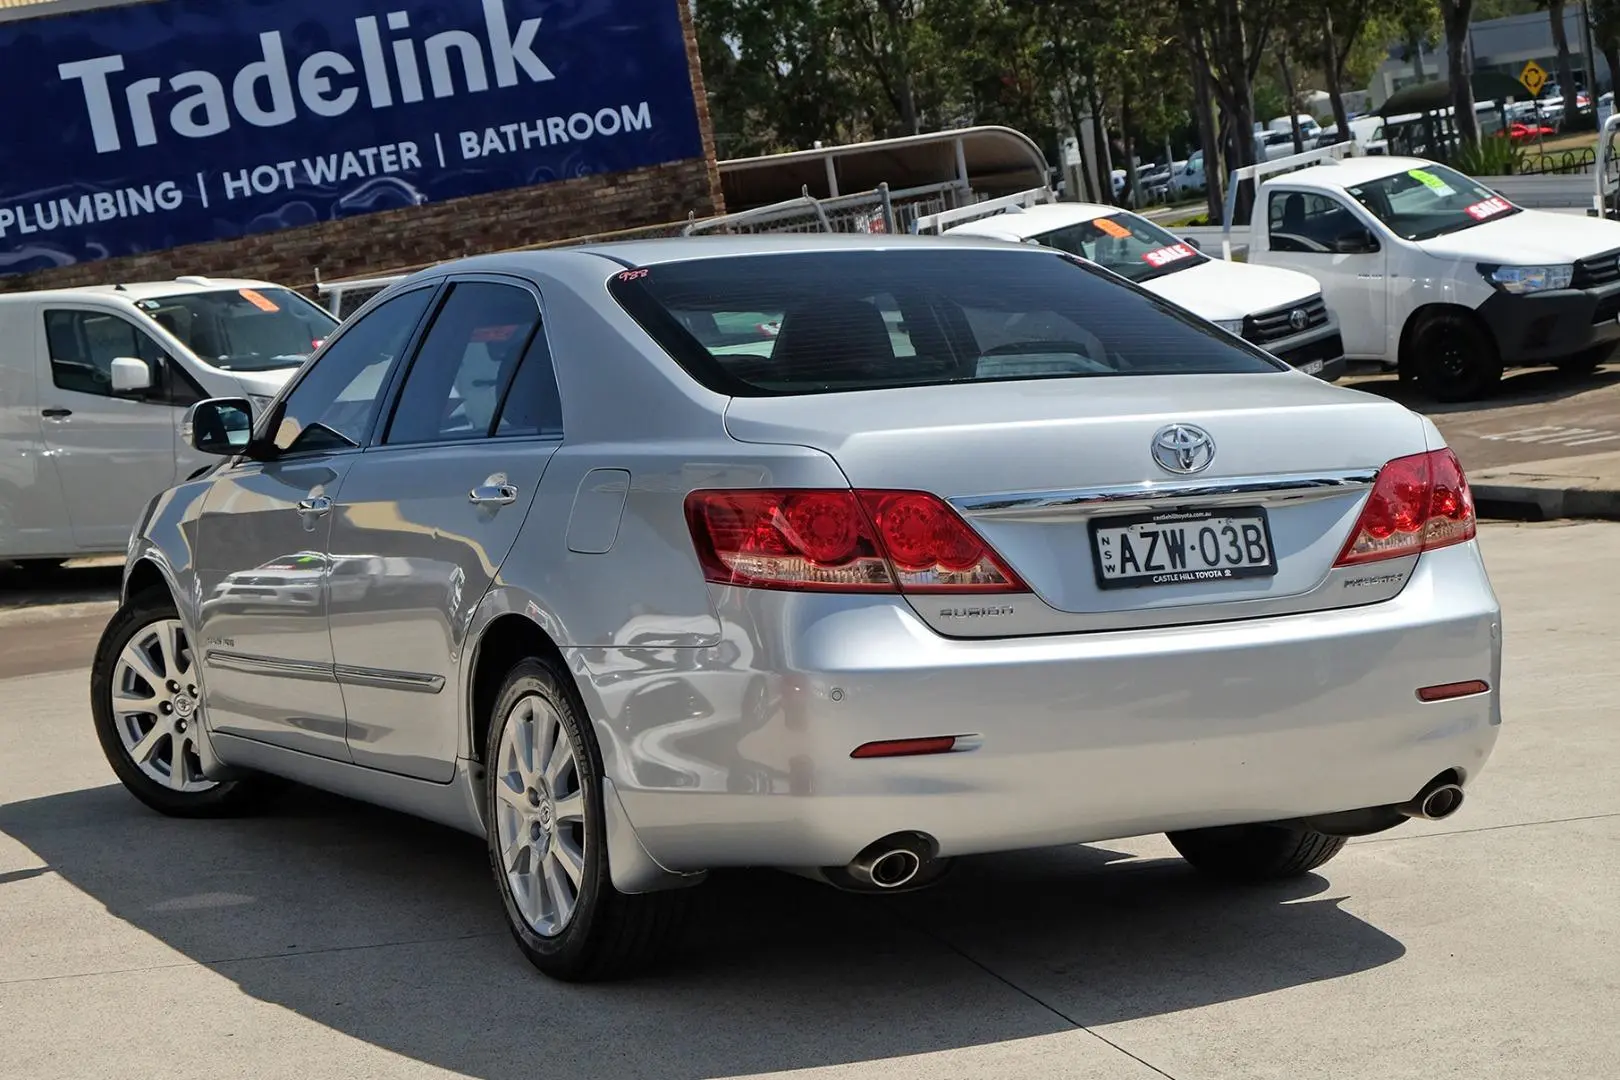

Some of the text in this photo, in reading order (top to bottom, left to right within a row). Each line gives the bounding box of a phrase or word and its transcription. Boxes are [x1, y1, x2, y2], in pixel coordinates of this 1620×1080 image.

[58, 0, 556, 153] Tradelink
[0, 101, 652, 238] PLUMBING HOT WATER BATHROOM
[1468, 197, 1509, 219] SALE
[1146, 244, 1192, 266] SALE
[1152, 511, 1212, 521] castlehilltoyota.com.au
[1152, 569, 1223, 583] CASTLE HILL TOYOTA
